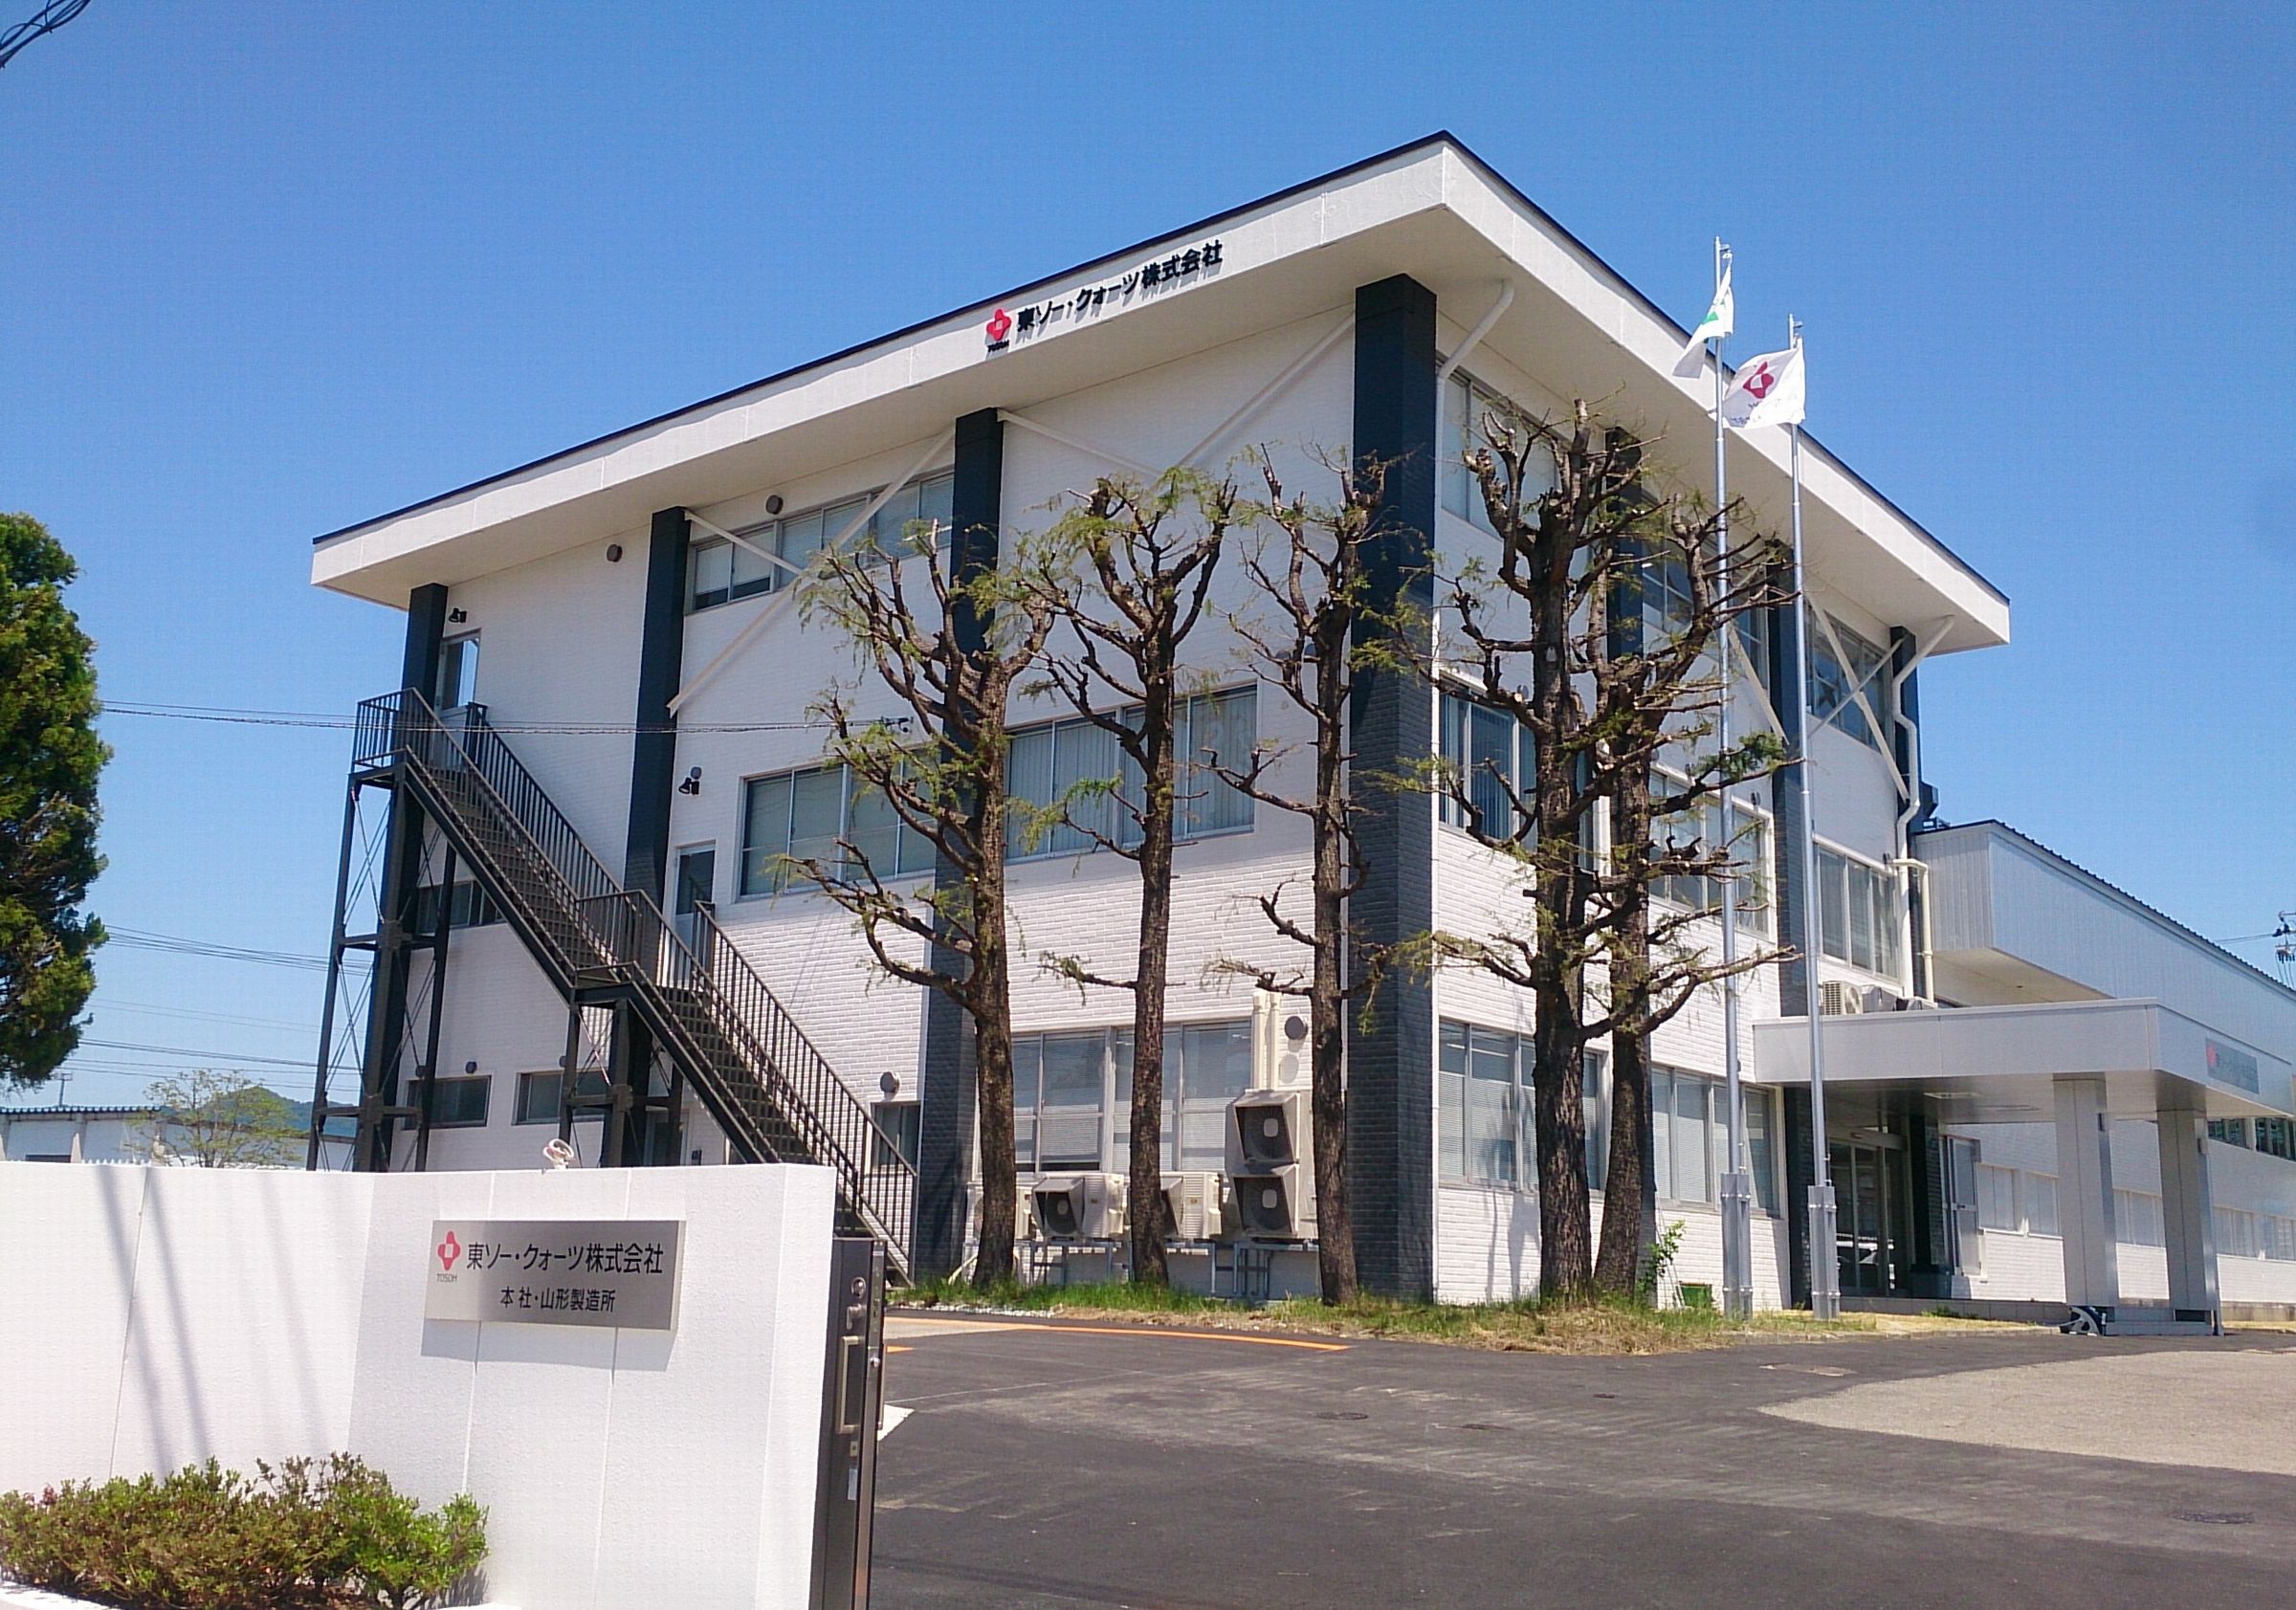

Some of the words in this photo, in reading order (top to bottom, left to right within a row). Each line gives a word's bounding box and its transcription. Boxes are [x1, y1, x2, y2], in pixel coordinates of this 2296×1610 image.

[1017, 239, 1224, 333] 東ソー・クォーツ株式会社
[466, 1242, 664, 1274] 東ソー・クォーツ株式会社
[436, 1273, 457, 1283] TOSOH
[499, 1286, 616, 1312] 本社・山形製造所
